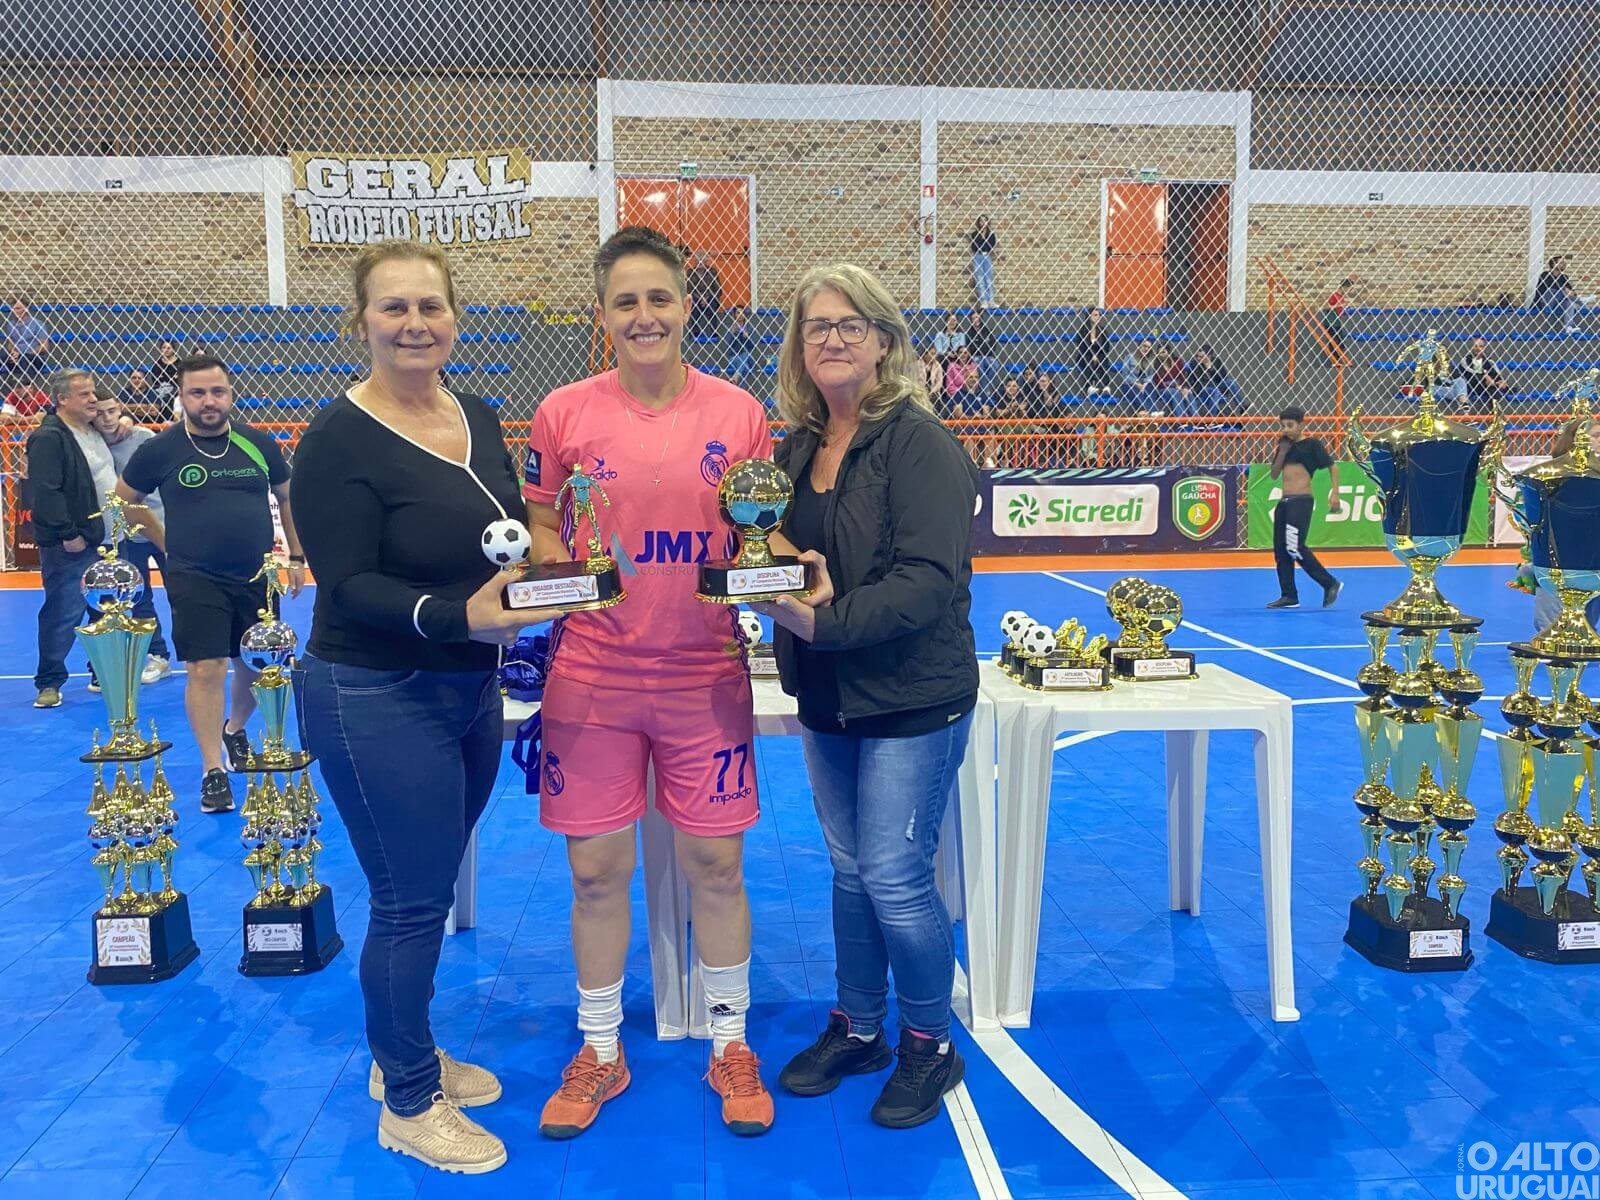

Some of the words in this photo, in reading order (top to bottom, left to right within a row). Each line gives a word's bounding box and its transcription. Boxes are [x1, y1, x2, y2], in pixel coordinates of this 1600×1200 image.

[304, 155, 526, 200] GERAL
[307, 204, 412, 245] RODEIO
[415, 201, 532, 244] FUTSAL
[1045, 498, 1144, 523] Sicredi
[634, 530, 714, 564] JMX
[713, 743, 748, 793] 77
